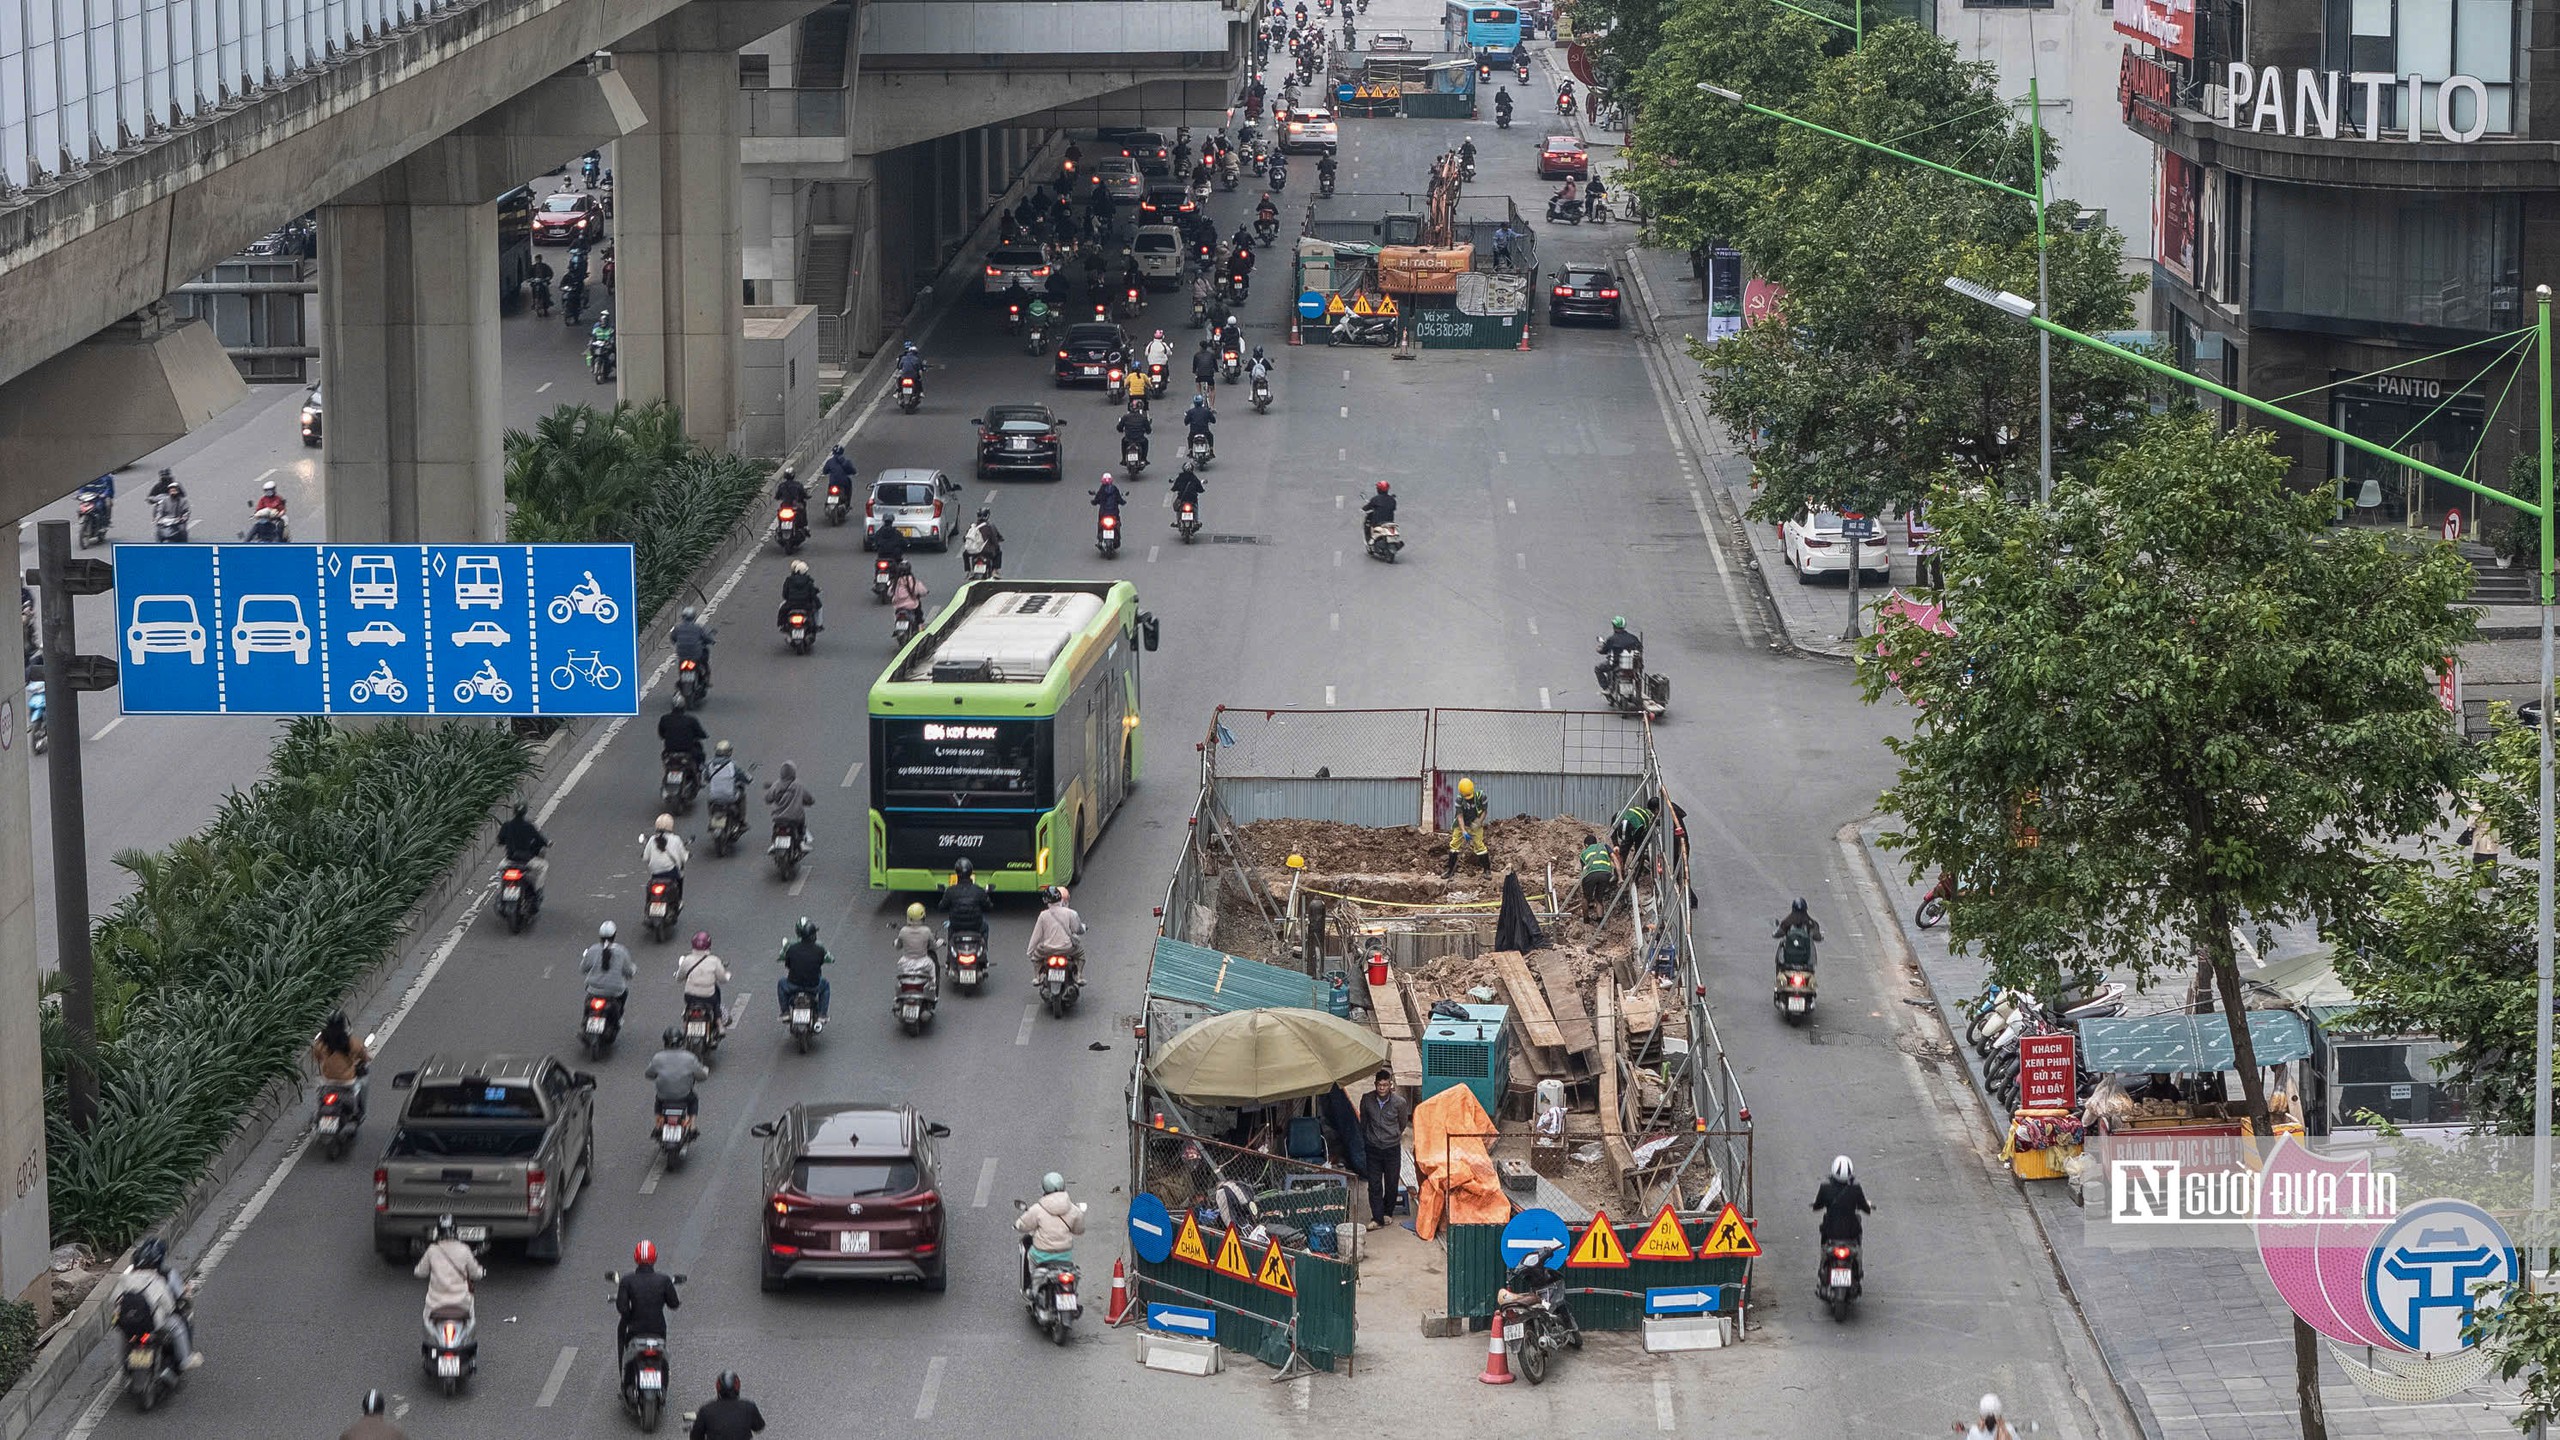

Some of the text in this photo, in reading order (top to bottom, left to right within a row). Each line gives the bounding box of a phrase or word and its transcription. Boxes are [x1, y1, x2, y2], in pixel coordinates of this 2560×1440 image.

[2228, 61, 2490, 143] PANTIO
[2378, 376, 2440, 399] PANTIO
[938, 835, 984, 848] 29F-02077
[1006, 861, 1033, 869] GREEN
[2031, 1043, 2062, 1054] KHÁCH
[2025, 1057, 2070, 1068] XEM PHIM
[2033, 1069, 2063, 1081] GỬI XE
[2031, 1083, 2065, 1096] TẠI ĐÂY
[1187, 1227, 1195, 1240] ĐI
[1661, 1223, 1671, 1235] ĐI
